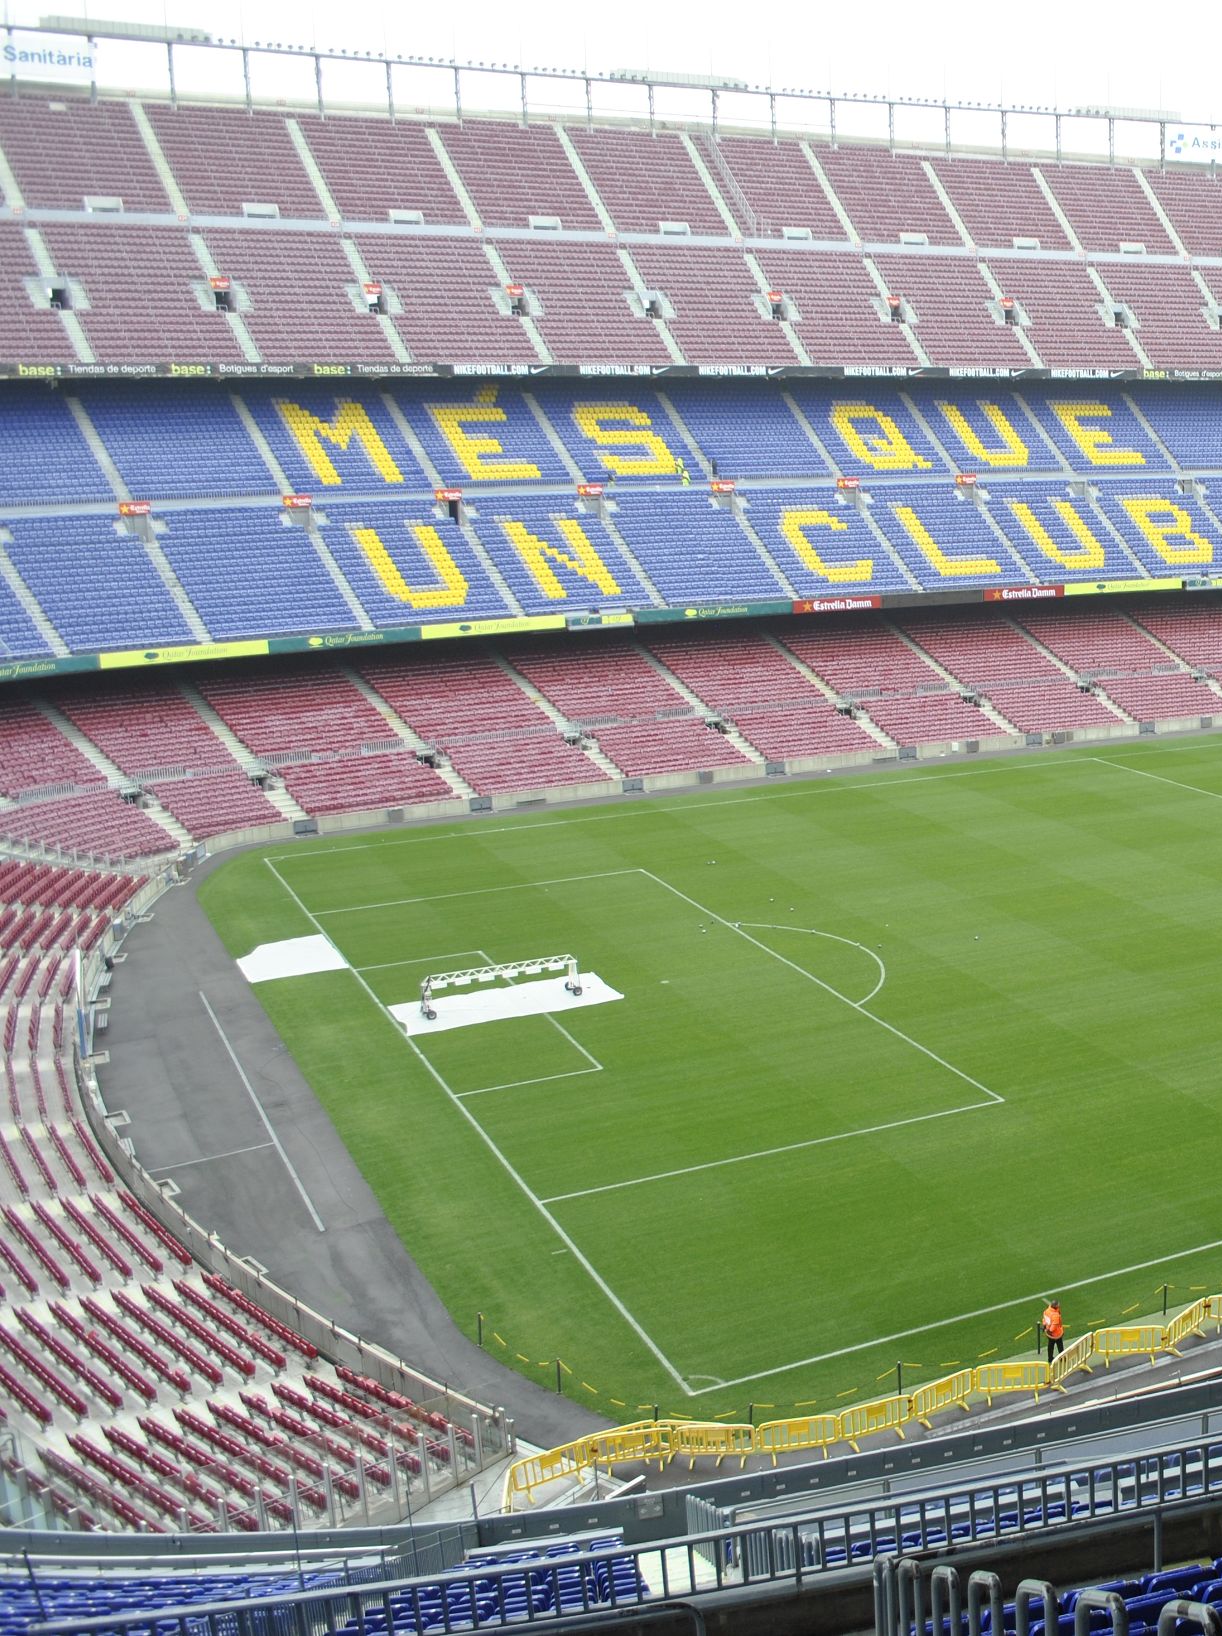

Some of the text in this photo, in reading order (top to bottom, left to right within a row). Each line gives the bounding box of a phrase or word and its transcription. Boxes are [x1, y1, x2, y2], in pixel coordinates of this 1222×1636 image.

[3, 44, 94, 68] Sanitària
[453, 364, 528, 375] NIKEFOOTBALL.COM
[699, 365, 766, 376] NIKEFOOTBALL.COM
[843, 366, 906, 376] NIKEFOOTBALL.COM
[274, 384, 1146, 485] MÉS QUE
[349, 498, 1214, 609] UN CLUB
[1002, 588, 1056, 599] Estrella Damm
[698, 606, 748, 617] Qatar Foundation
[813, 599, 872, 611] Estrella Damm
[325, 633, 384, 647] Qatar Foundation
[162, 646, 228, 661] Qatar Foundation
[12, 662, 56, 679] Foundation
